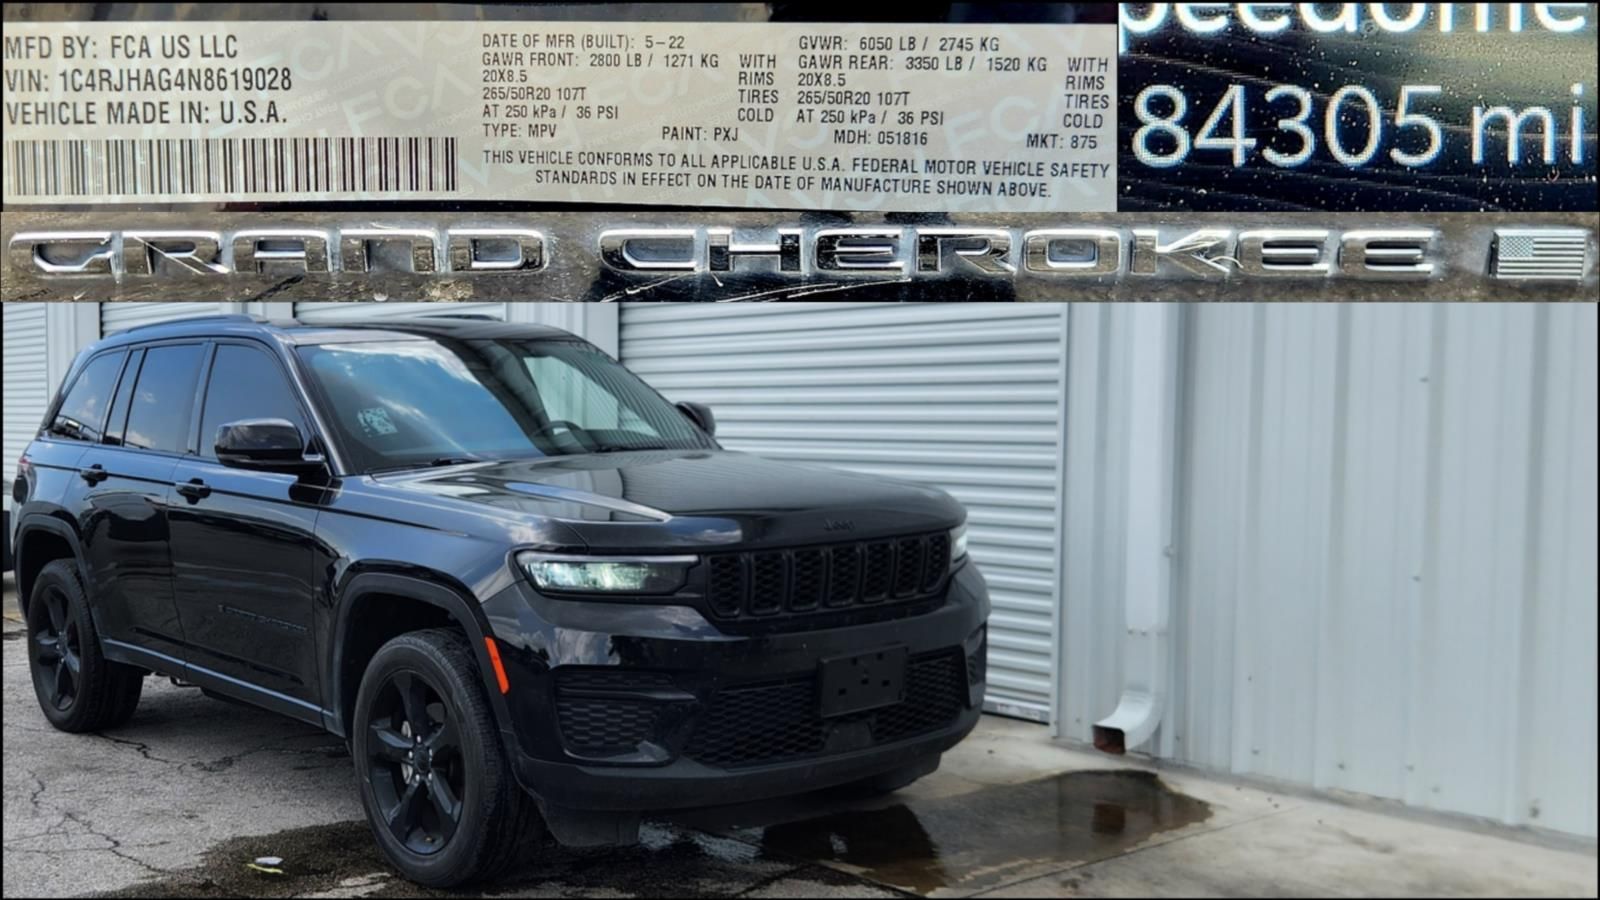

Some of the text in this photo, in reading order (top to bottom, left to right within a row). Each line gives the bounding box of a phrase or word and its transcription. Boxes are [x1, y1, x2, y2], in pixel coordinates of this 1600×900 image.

[5, 34, 238, 59] MFD BY: FCA US LLC
[483, 33, 517, 48] DATE
[523, 34, 539, 48] OF
[546, 34, 575, 48] MFR
[581, 34, 634, 52] (BUILT):
[799, 35, 999, 51] GVWR: 6050 LB / 2745 KG
[482, 52, 718, 68] GAWR FRONT: 2800 LB / 1271 KG
[739, 54, 776, 69] WITH
[799, 54, 1047, 72] GAWR REAR: 3350 LB / 1520 KG
[1068, 57, 1108, 72] WITH
[4, 67, 292, 92] VIN: 1C4RJHAG4N8619028
[483, 69, 528, 83] 20X8.5
[738, 71, 774, 86] RIMS
[798, 72, 846, 87] 20X8.5
[1065, 75, 1105, 90] RIMS
[483, 86, 587, 101] 265/50R20 107T
[738, 89, 779, 104] TIRES
[797, 90, 910, 106] 265/50R20 107T
[1064, 94, 1109, 109] TIRES
[6, 102, 97, 125] VEHICLE
[107, 101, 170, 125] MADE
[180, 101, 209, 124] IN:
[220, 100, 287, 124] U.S.A.
[483, 104, 618, 119] AT 250 kPa / 36 PSI
[738, 107, 774, 122] COLD
[796, 108, 944, 125] AT 250 kPa / 36 PSI
[1063, 113, 1103, 129] COLD
[1132, 84, 1444, 168] 84305
[1471, 82, 1584, 165] mi
[483, 123, 556, 138] TYPE: MPV
[662, 126, 738, 141] PAINT: PXJ
[834, 129, 928, 146] MDH: 051816
[1026, 133, 1097, 149] MKT: 875
[484, 150, 1110, 178] THIS VEHICLE CONFORMS TO ALL APPLICABLE U.S.A. FEDERAL MOTOR VEHICLE SAFETY
[536, 169, 1051, 197] STANDARDS IN EFFECT ON THE DATE OF MANUFACTURE SHOWN ABOVE.
[9, 228, 1440, 277] GRAND CHEROKEE
